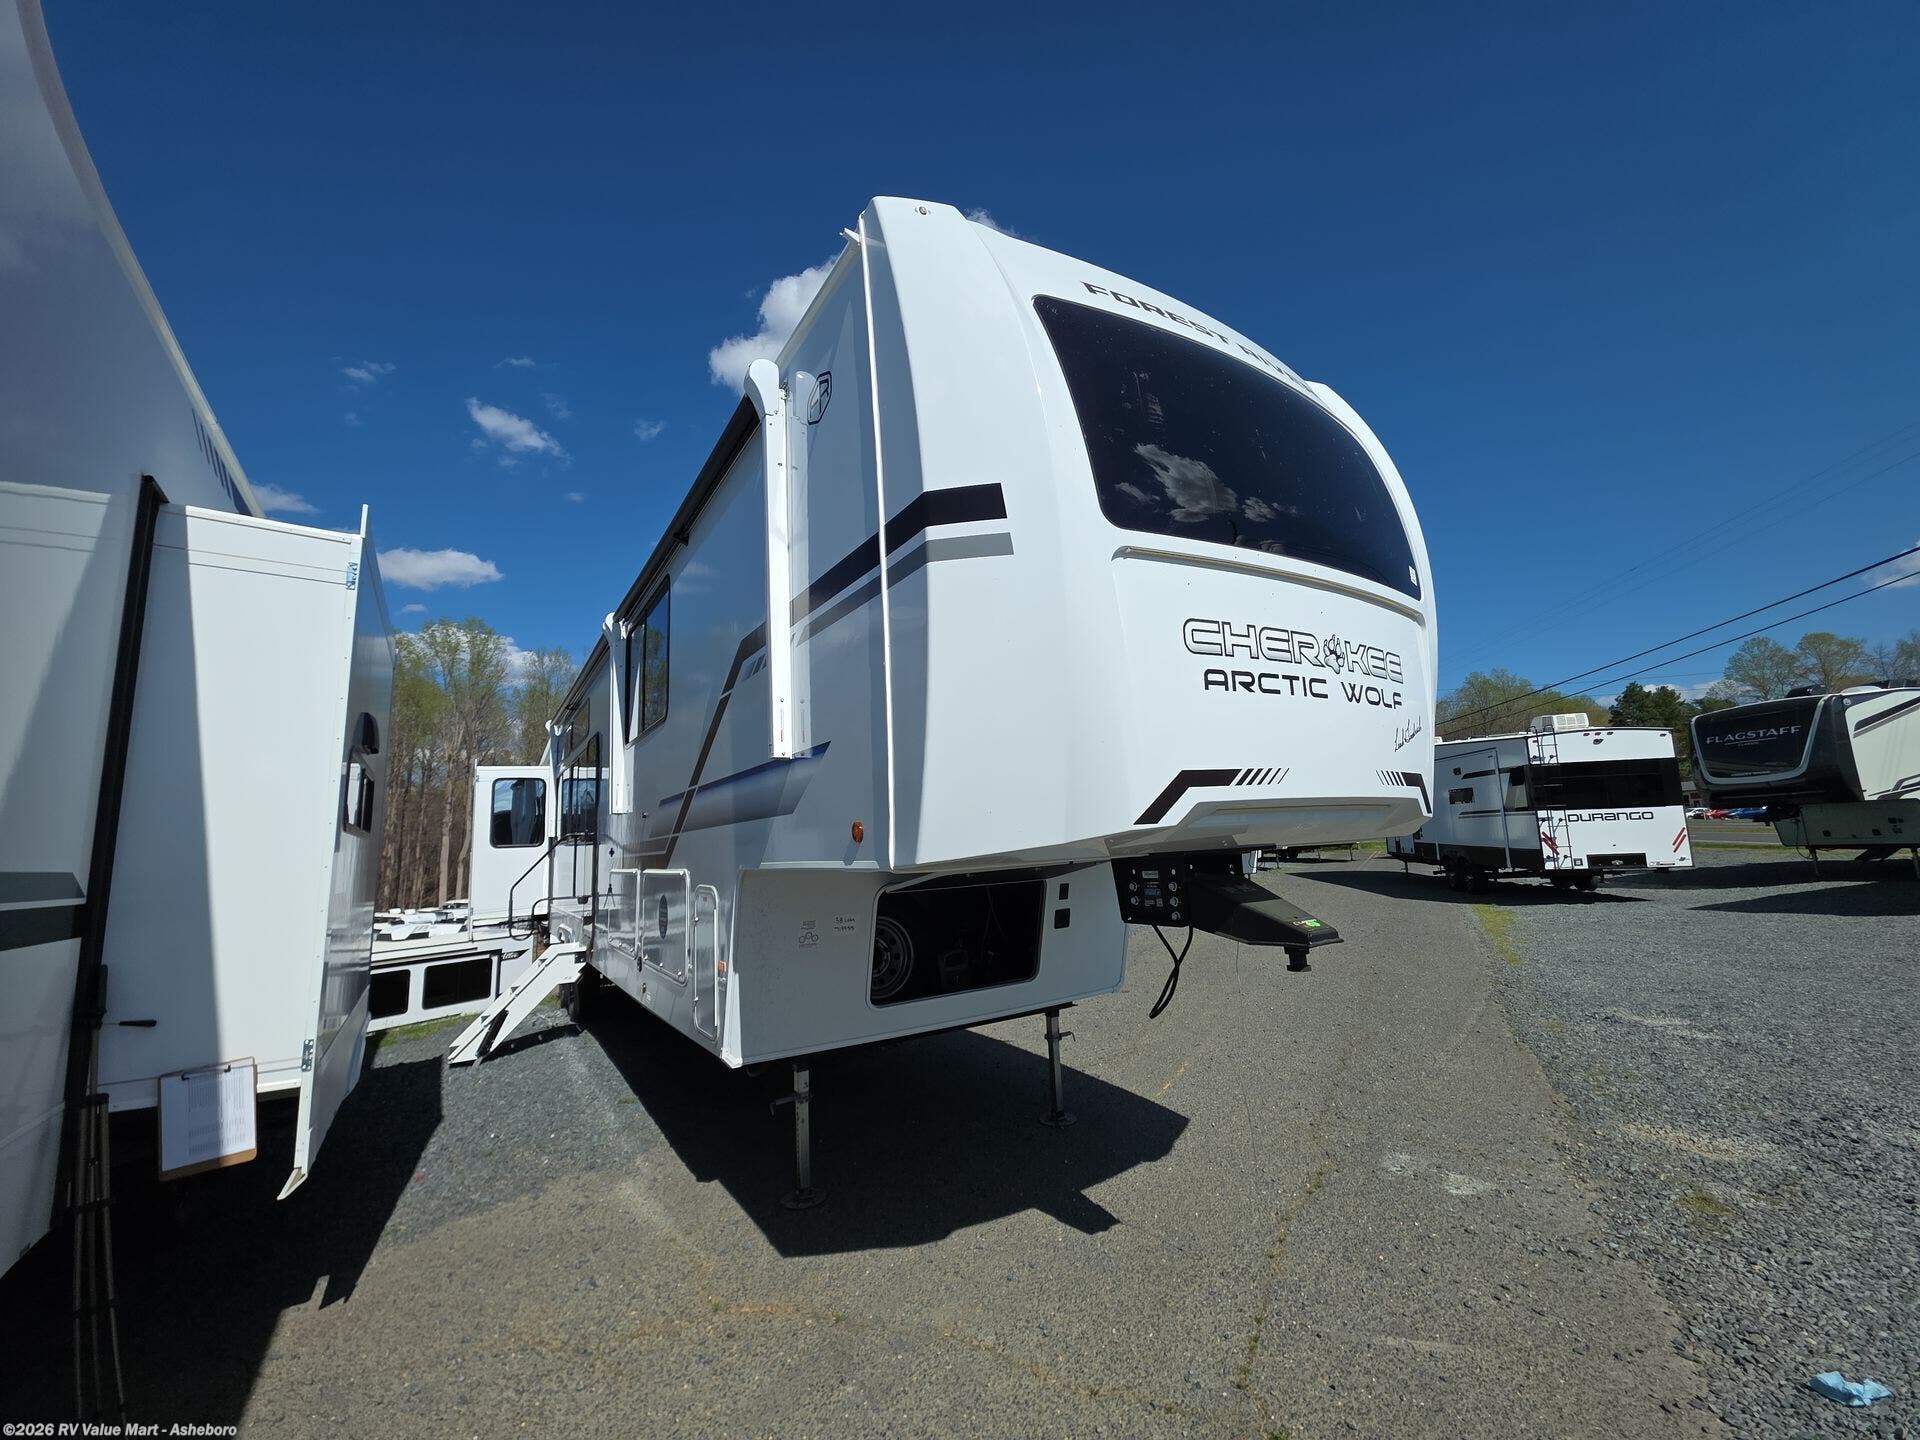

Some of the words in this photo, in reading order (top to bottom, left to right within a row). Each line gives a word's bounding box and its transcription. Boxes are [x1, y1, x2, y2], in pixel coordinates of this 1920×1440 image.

[1080, 280, 1229, 344] FOREST
[1203, 668, 1329, 699] ARCTIC
[1341, 681, 1402, 709] WOLF
[1706, 725, 1801, 744] FLAGSTAFF
